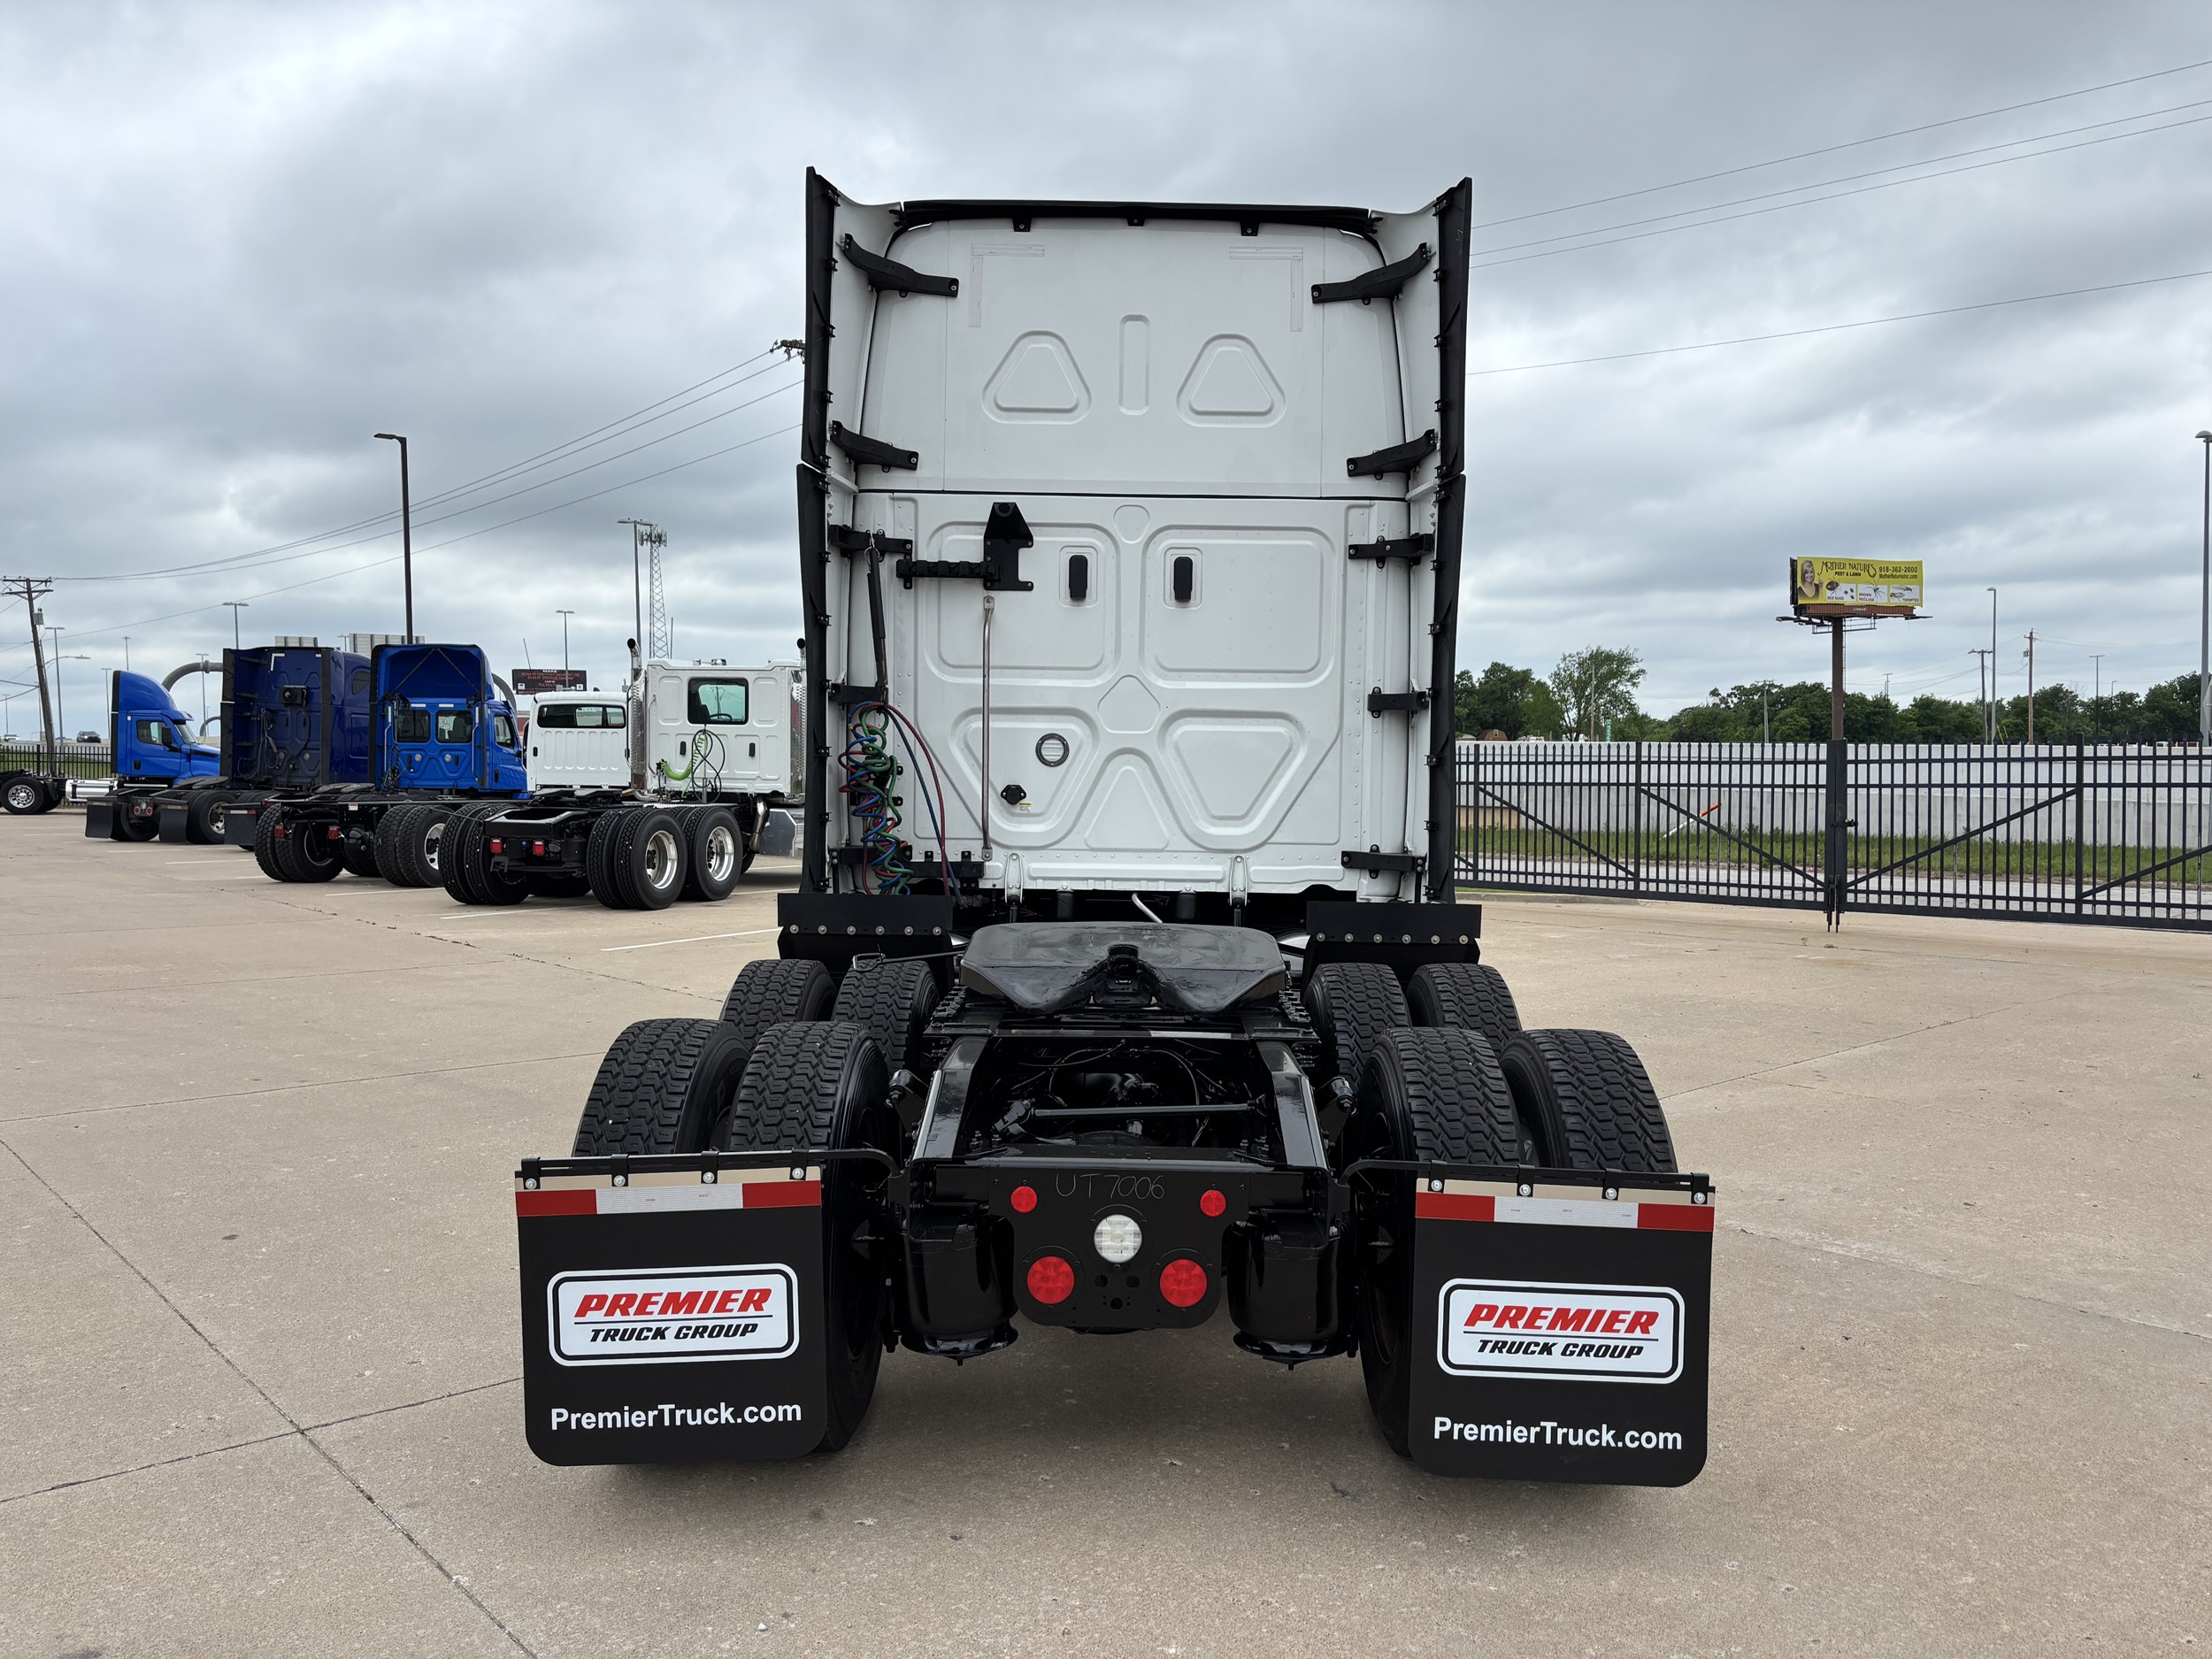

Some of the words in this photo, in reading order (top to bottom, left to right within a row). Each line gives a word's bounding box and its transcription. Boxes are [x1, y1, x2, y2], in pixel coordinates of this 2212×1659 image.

[1817, 561, 1847, 575] MOTHER
[574, 1288, 772, 1318] PREMIER
[589, 1326, 671, 1342] TRUCK
[673, 1323, 759, 1340] GROUP
[1463, 1303, 1659, 1334] PREMIER
[1477, 1339, 1558, 1356] TRUCK
[1560, 1342, 1644, 1359] GROUP
[550, 1402, 803, 1431] PremierTruck.com
[1433, 1417, 1682, 1450] PremierTruck.com
